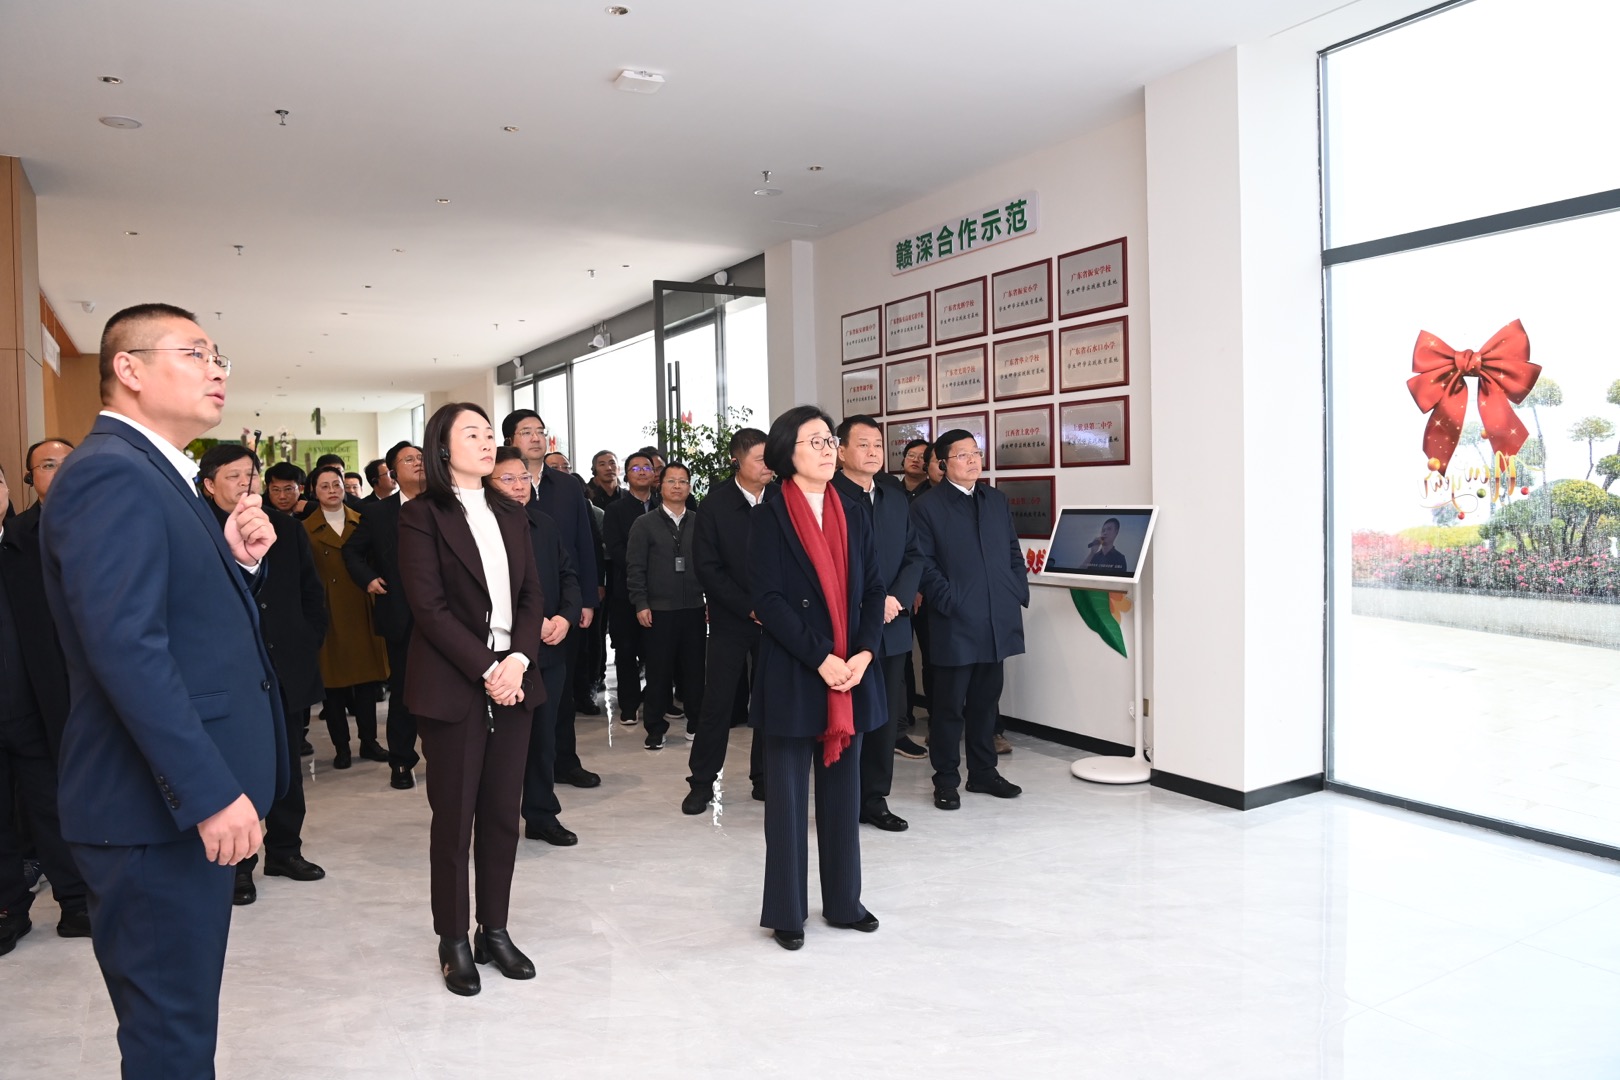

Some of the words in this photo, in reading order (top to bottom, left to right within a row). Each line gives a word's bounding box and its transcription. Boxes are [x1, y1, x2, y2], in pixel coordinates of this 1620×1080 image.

[896, 199, 1027, 270] 赣深合作示范
[1069, 341, 1116, 357] 广东省石水口小学
